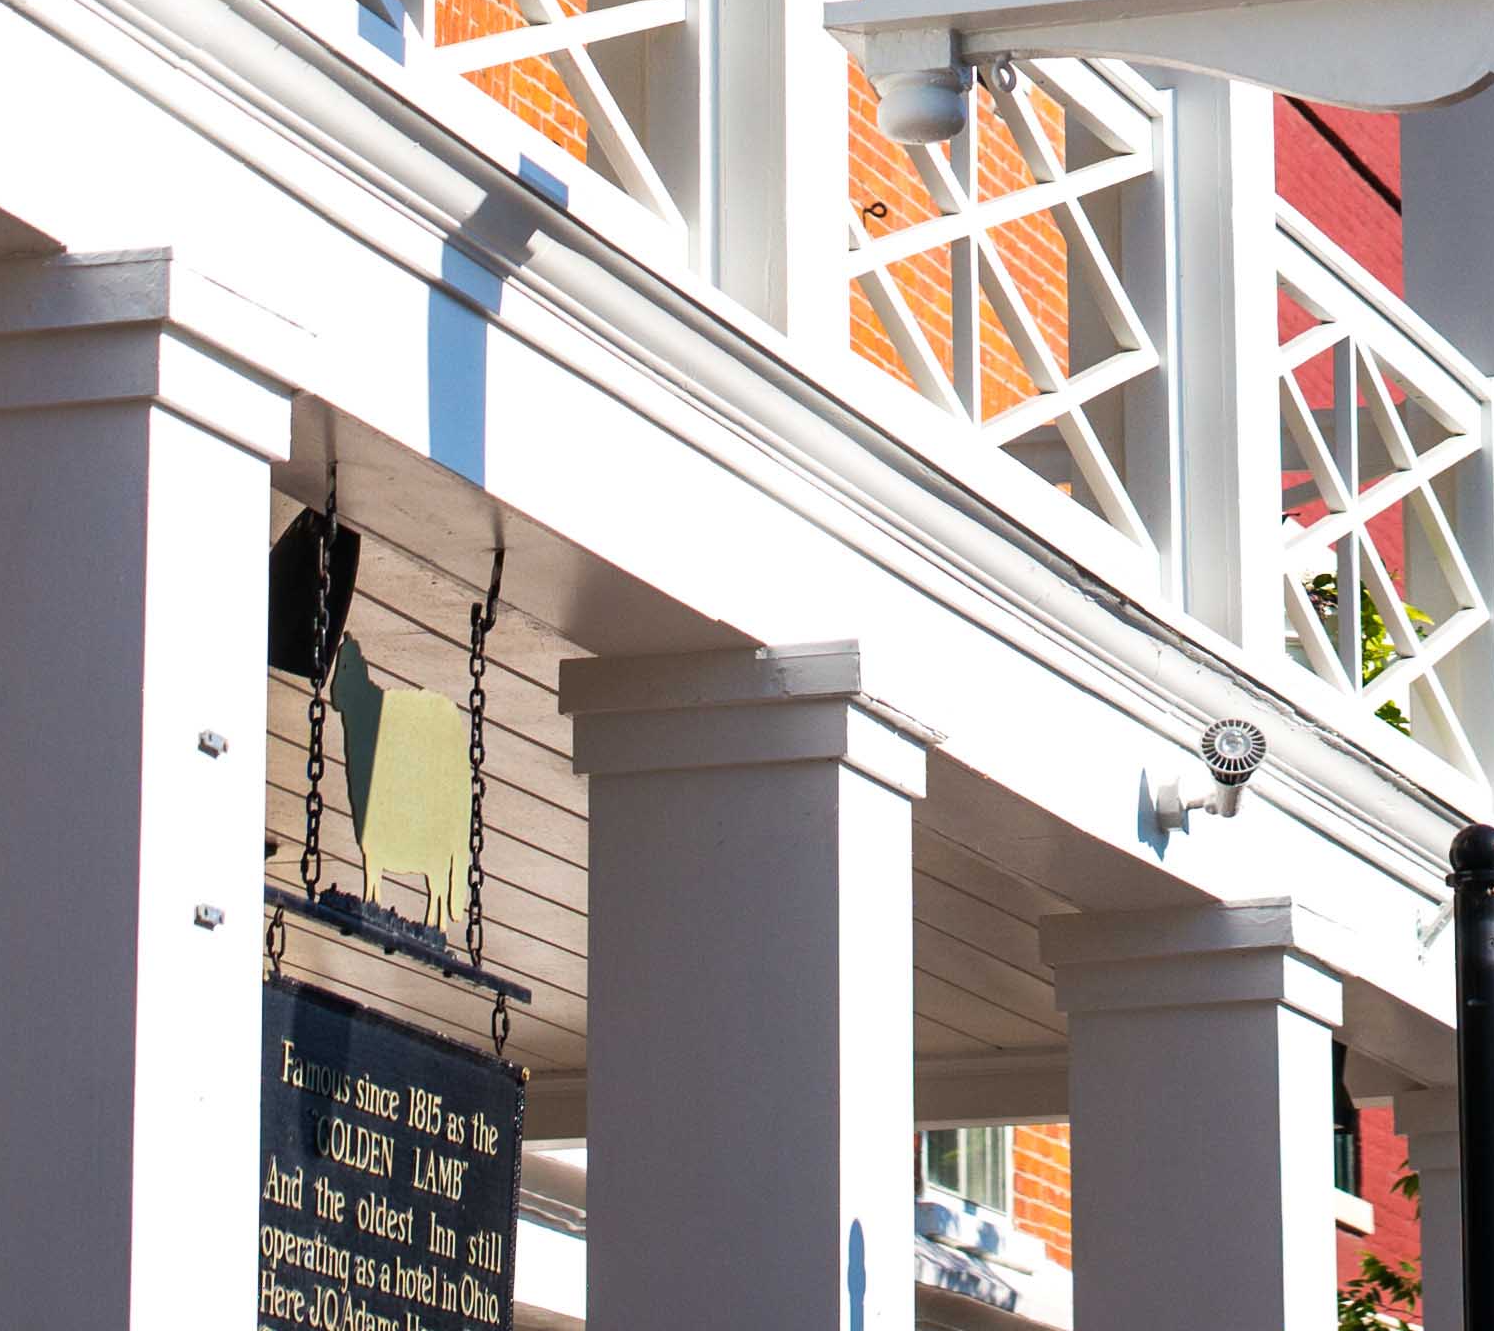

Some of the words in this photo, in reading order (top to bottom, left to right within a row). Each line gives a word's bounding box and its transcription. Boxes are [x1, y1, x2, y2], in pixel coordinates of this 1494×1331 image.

[282, 1040, 350, 1103] Famous
[356, 1073, 399, 1120] since
[408, 1087, 442, 1135] 1815
[447, 1113, 465, 1144] as
[472, 1113, 498, 1155] the
[263, 1155, 303, 1210] And
[315, 1177, 345, 1222] the
[358, 1192, 413, 1244] oldest
[429, 1212, 456, 1258] Inn
[468, 1231, 502, 1273] still
[260, 1271, 305, 1322] Here
[261, 1225, 349, 1293] operating
[355, 1256, 375, 1288] as
[380, 1264, 390, 1293] a
[395, 1256, 437, 1306] hotel
[442, 1273, 457, 1312] in
[460, 1274, 500, 1324] Ohio.
